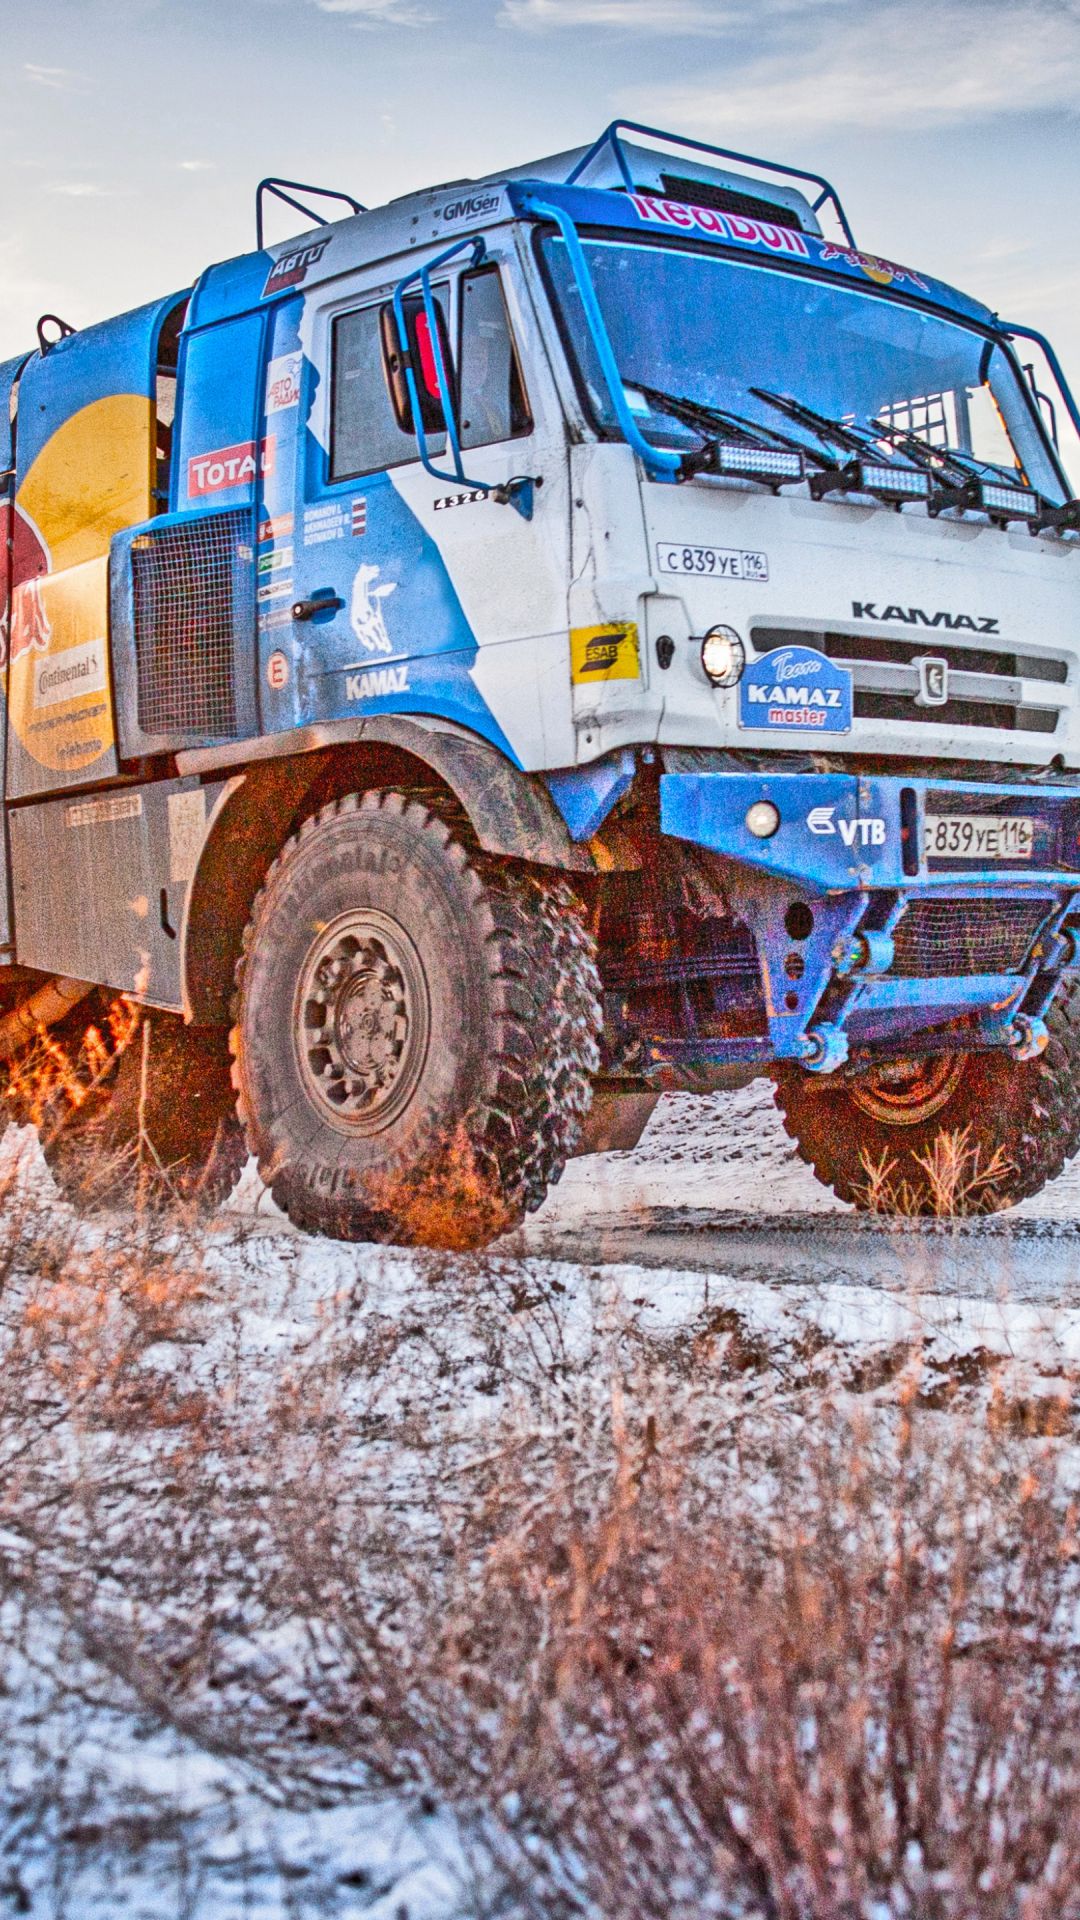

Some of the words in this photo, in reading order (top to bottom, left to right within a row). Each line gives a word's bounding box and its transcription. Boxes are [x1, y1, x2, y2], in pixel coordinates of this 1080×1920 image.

[192, 452, 272, 489] TOTAL
[435, 489, 486, 509] 4326
[852, 601, 1000, 634] KAMAZ
[586, 645, 619, 661] ESAB
[772, 652, 822, 682] Team
[38, 656, 91, 695] Continental
[345, 666, 410, 701] KAMAZ
[747, 684, 843, 708] KAMAZ
[769, 708, 826, 725] master
[838, 818, 886, 846] VTB
